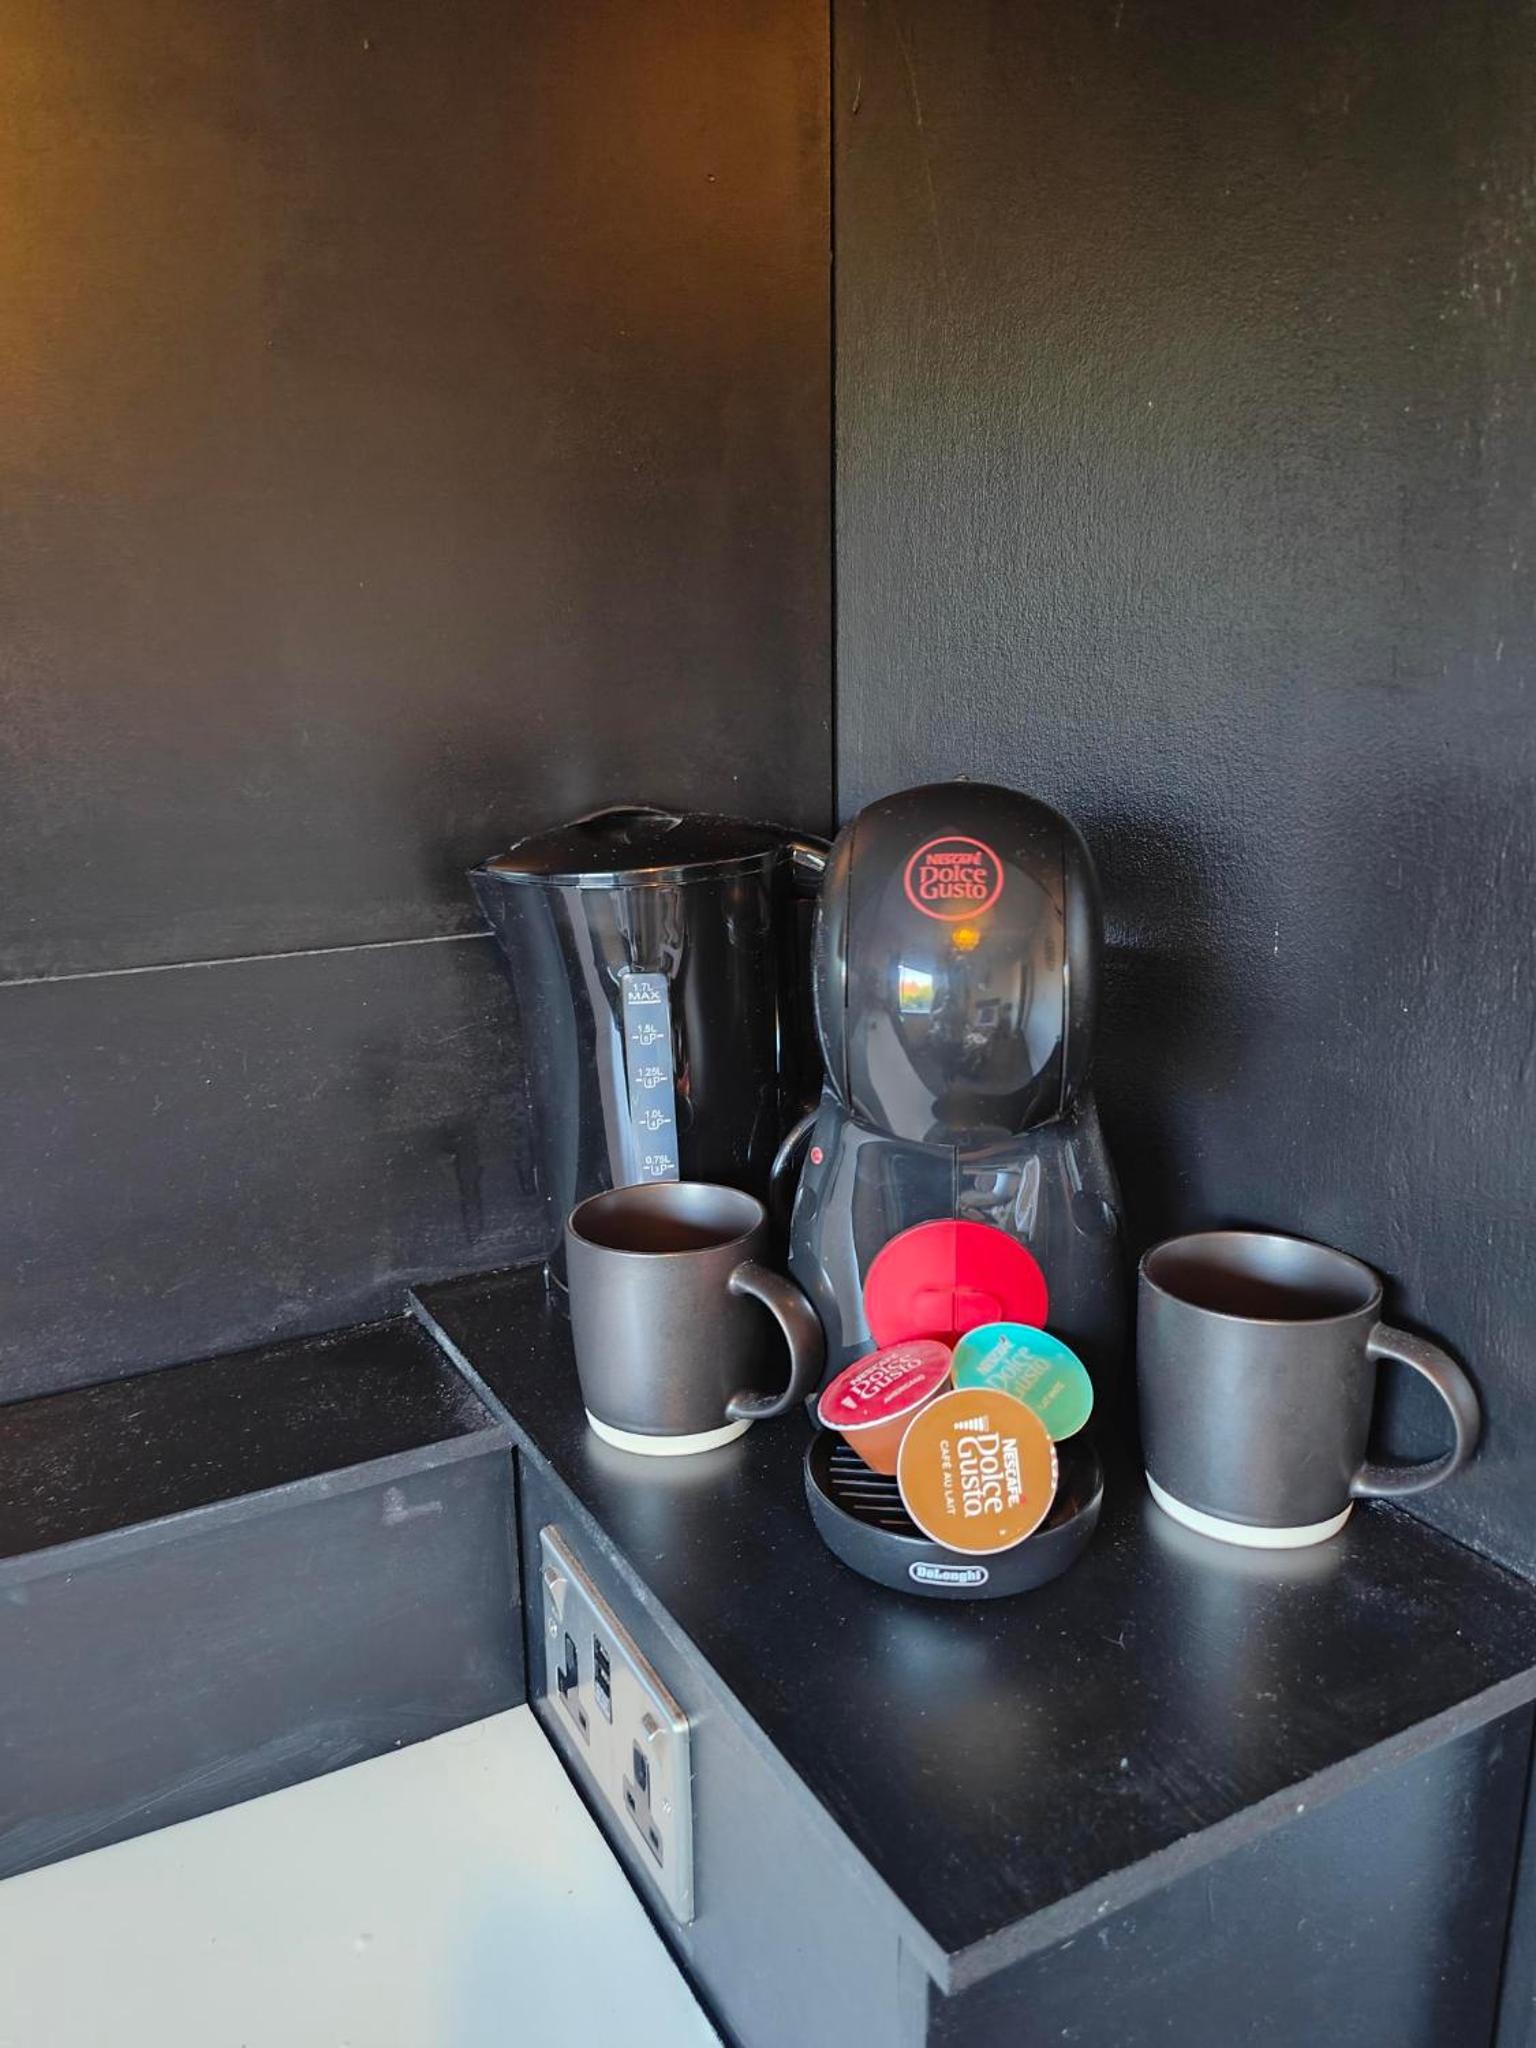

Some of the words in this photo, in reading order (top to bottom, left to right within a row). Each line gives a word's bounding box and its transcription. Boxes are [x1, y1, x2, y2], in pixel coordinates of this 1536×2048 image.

[919, 865, 987, 884] Dolce
[920, 882, 988, 900] Gusto
[628, 991, 660, 1001] MAX
[850, 1354, 912, 1396] Dolce
[860, 1359, 922, 1399] Gusto
[943, 1471, 952, 1489] AU
[956, 1435, 984, 1518] Gusto
[976, 1431, 1004, 1515] Dolce
[943, 1490, 956, 1516] LAIT
